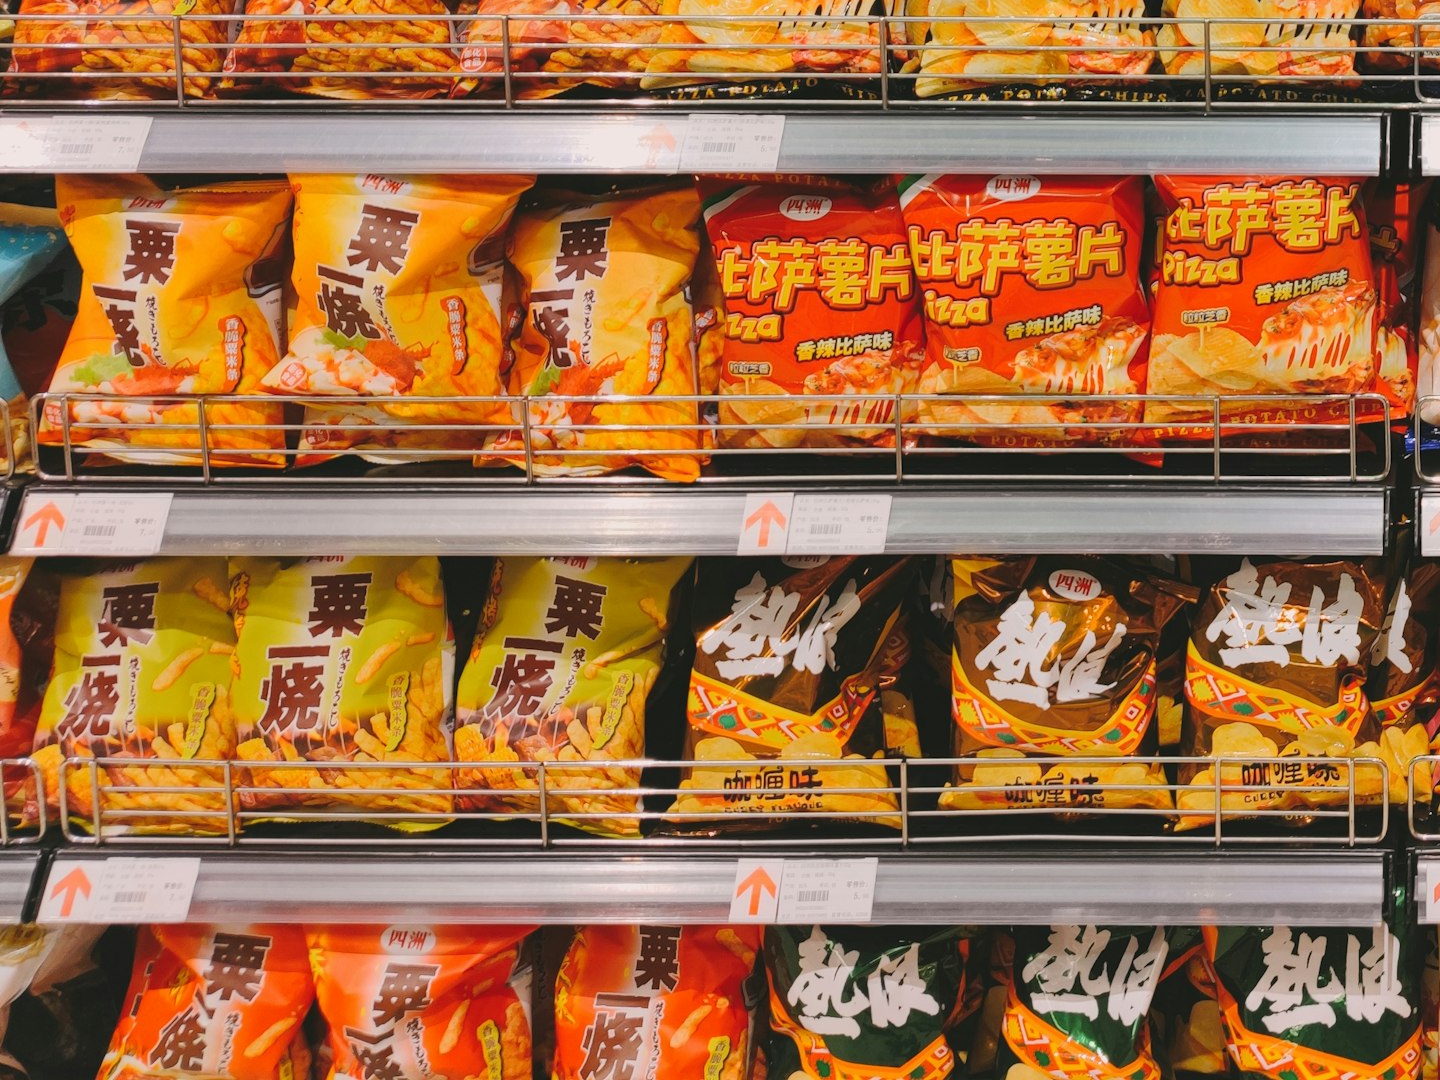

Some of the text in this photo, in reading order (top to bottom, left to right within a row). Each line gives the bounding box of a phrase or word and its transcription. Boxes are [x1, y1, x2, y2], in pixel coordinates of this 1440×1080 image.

[995, 177, 1037, 195] 四洲
[1165, 181, 1361, 252] 比萨薯片
[909, 219, 1126, 294] 比萨薯片
[1163, 255, 1239, 285] Pizza
[1256, 270, 1349, 304] 香辣比萨味
[927, 292, 990, 323] izza
[1006, 307, 1101, 340] 香辣比萨味
[797, 333, 892, 361] 香辣比萨味
[1055, 576, 1095, 596] 四洲
[724, 765, 824, 805] 咖喱味
[1242, 754, 1339, 791] 咖喱味
[389, 930, 432, 949] 四洲
